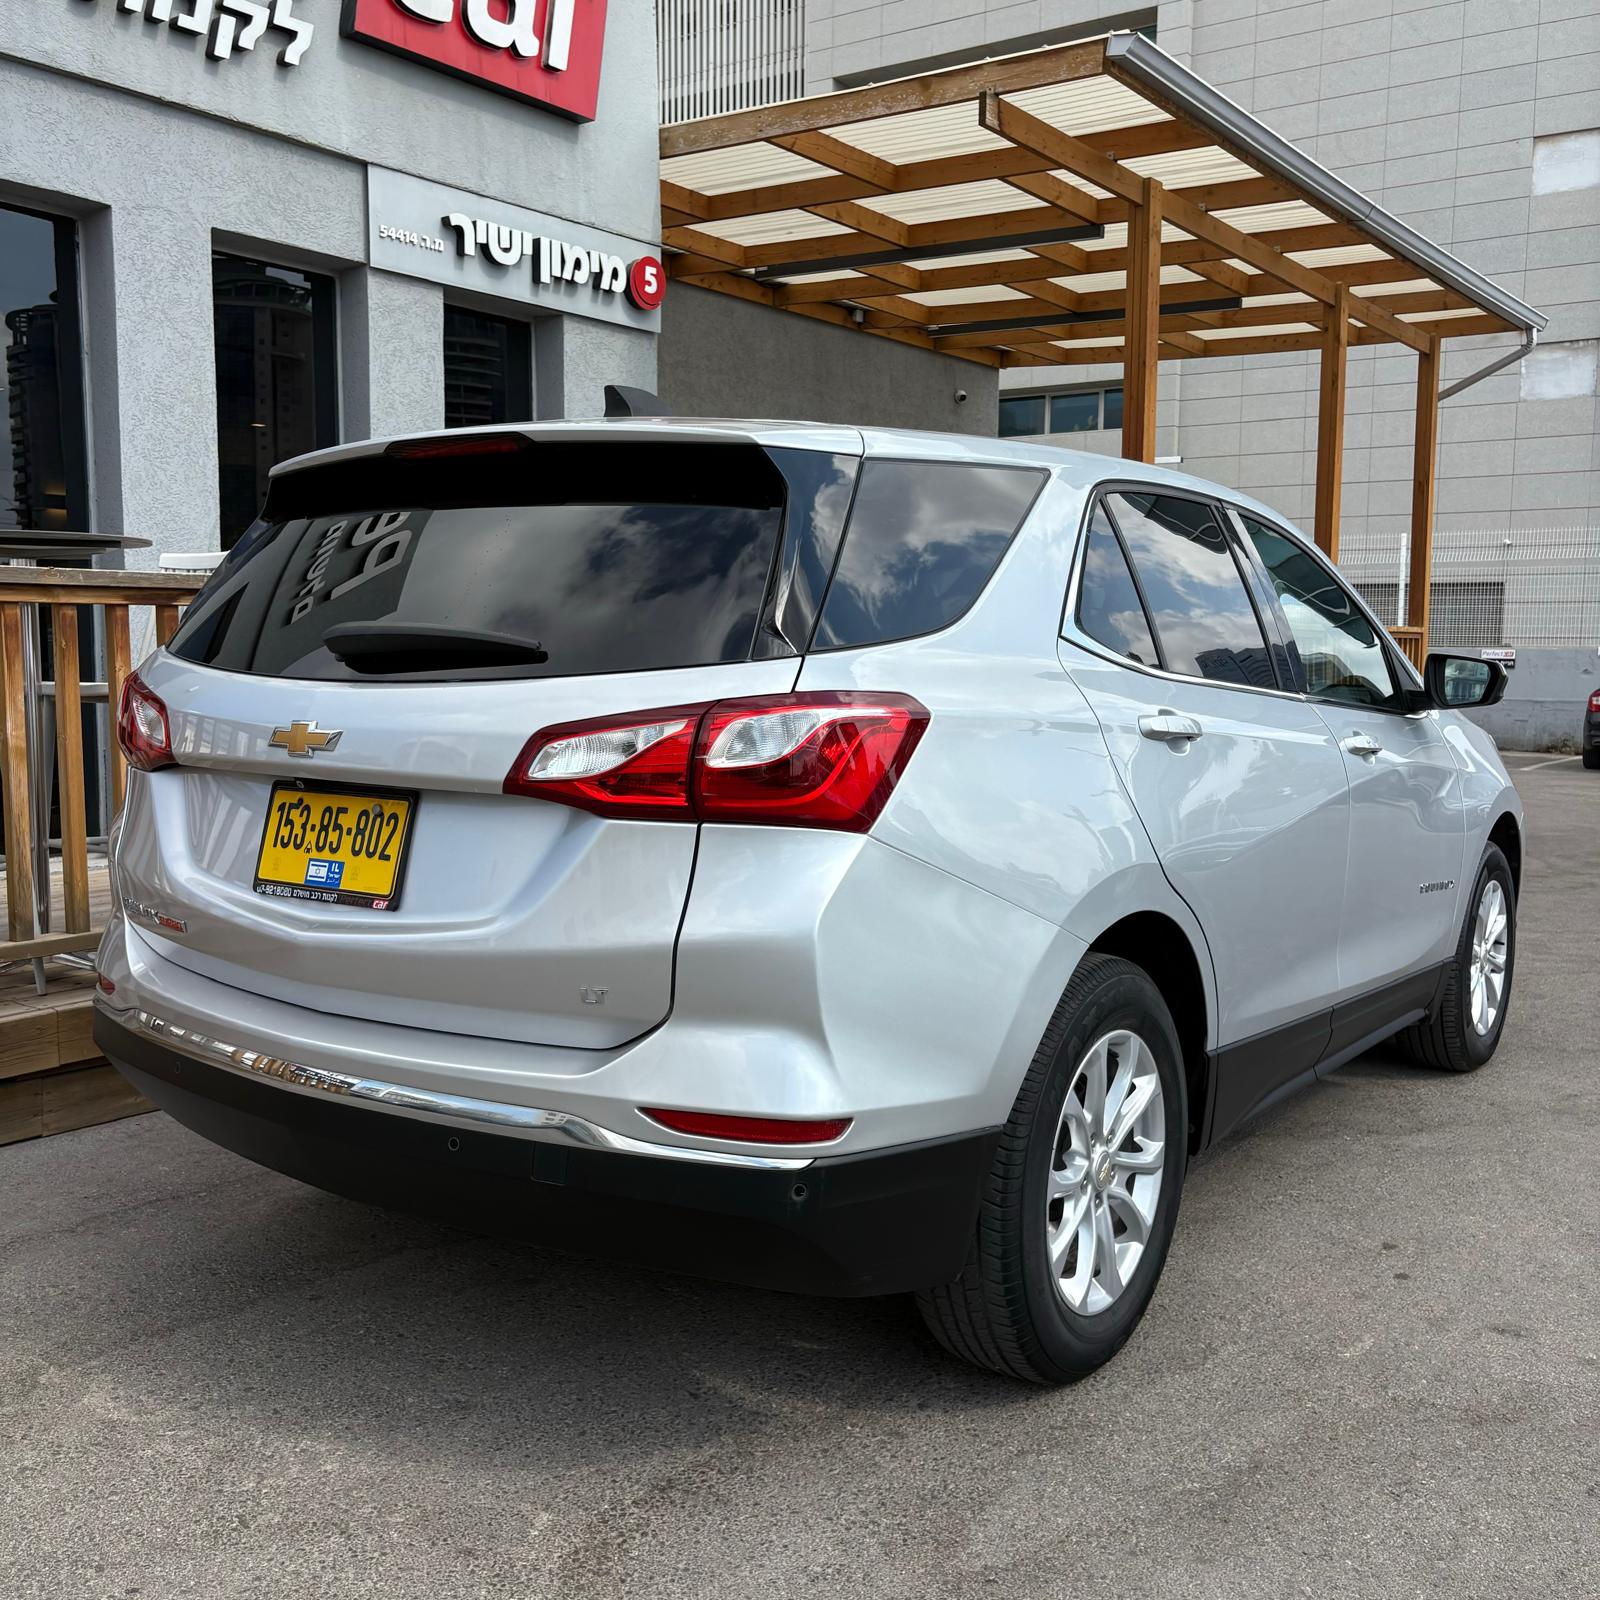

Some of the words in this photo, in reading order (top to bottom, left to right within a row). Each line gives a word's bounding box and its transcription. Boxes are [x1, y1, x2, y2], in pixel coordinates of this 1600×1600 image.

[379, 224, 419, 246] 54414
[446, 212, 533, 266] ישיר
[536, 236, 628, 293] מימון
[644, 265, 658, 294] 5
[331, 862, 340, 873] IL
[372, 900, 389, 910] car
[579, 985, 609, 1005] LT
